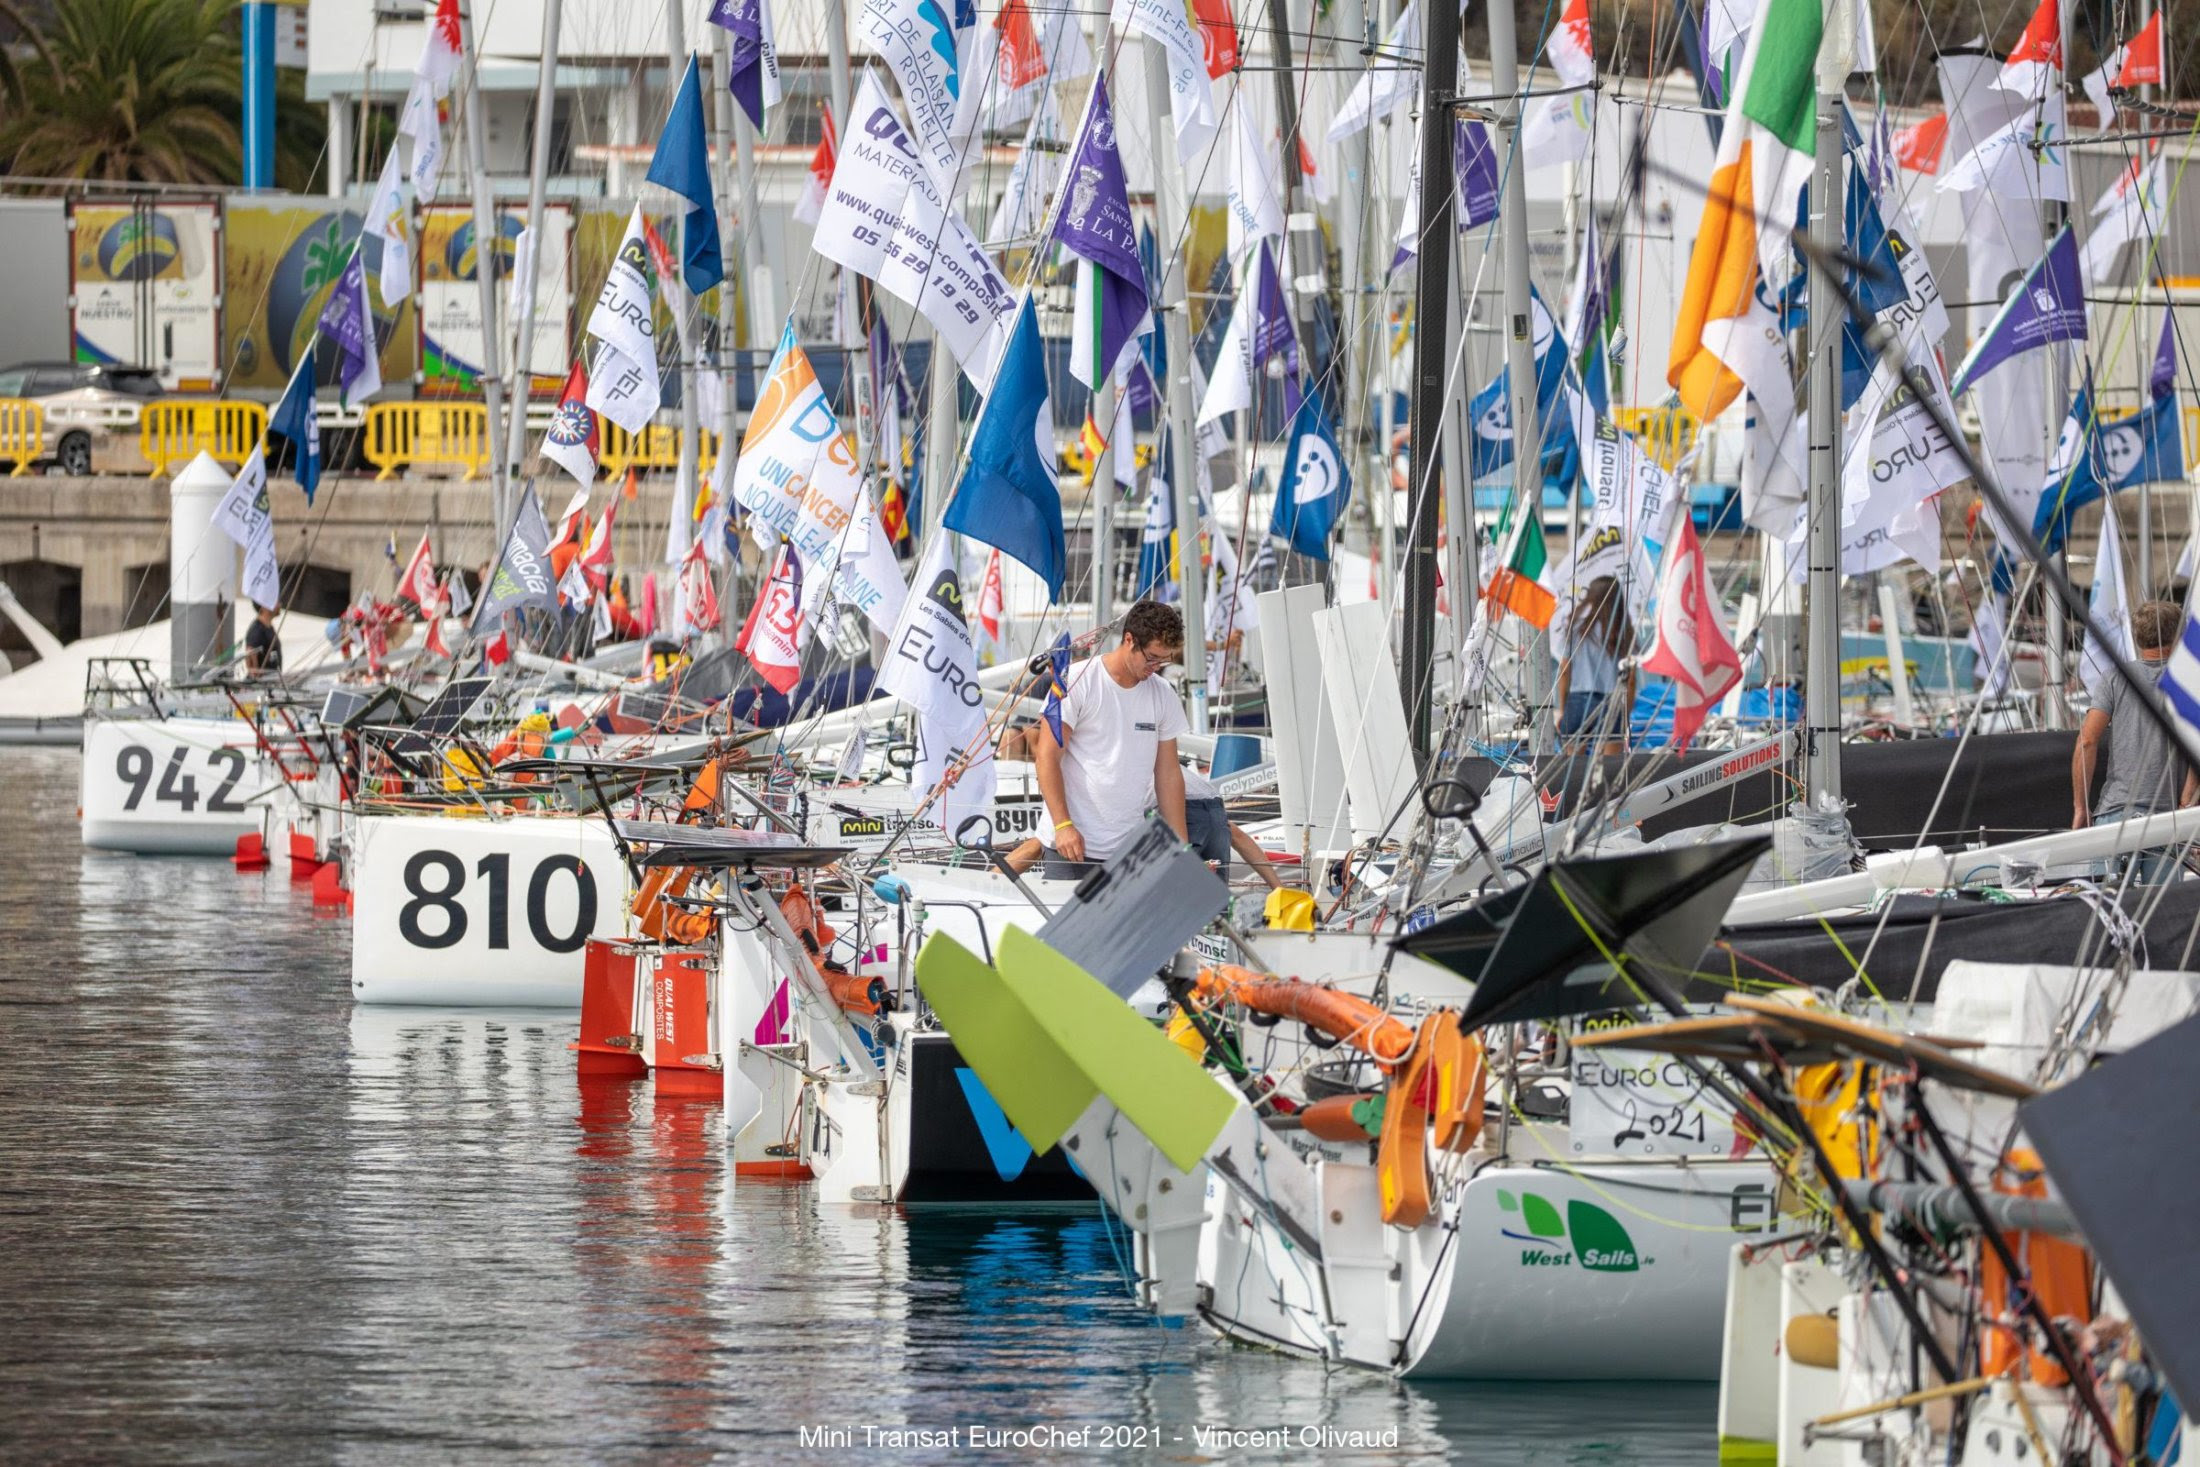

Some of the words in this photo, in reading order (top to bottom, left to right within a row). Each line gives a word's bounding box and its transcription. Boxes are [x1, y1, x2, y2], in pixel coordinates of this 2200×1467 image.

[897, 17, 921, 45] DE
[870, 20, 894, 47] LA
[900, 55, 956, 169] ROCHELLE
[1091, 215, 1115, 242] LA
[1101, 203, 1133, 234] SANTA
[852, 224, 882, 247] 05
[901, 250, 931, 276] 29
[932, 274, 958, 299] 19
[955, 297, 981, 325] 29
[597, 280, 654, 338] EURO
[758, 455, 851, 537] UNICANCER
[918, 602, 934, 617] Les
[933, 610, 959, 635] Sables
[898, 623, 984, 708] EURO
[115, 744, 247, 813] 942
[399, 849, 599, 954] 810
[655, 981, 665, 1040] COMPOSITES
[664, 977, 673, 1009] QUAI
[665, 1011, 674, 1045] WEST
[1577, 1061, 1657, 1088] EURO
[1613, 1098, 1705, 1149] 2021
[1520, 1249, 1573, 1266] West
[1583, 1248, 1635, 1267] Sails
